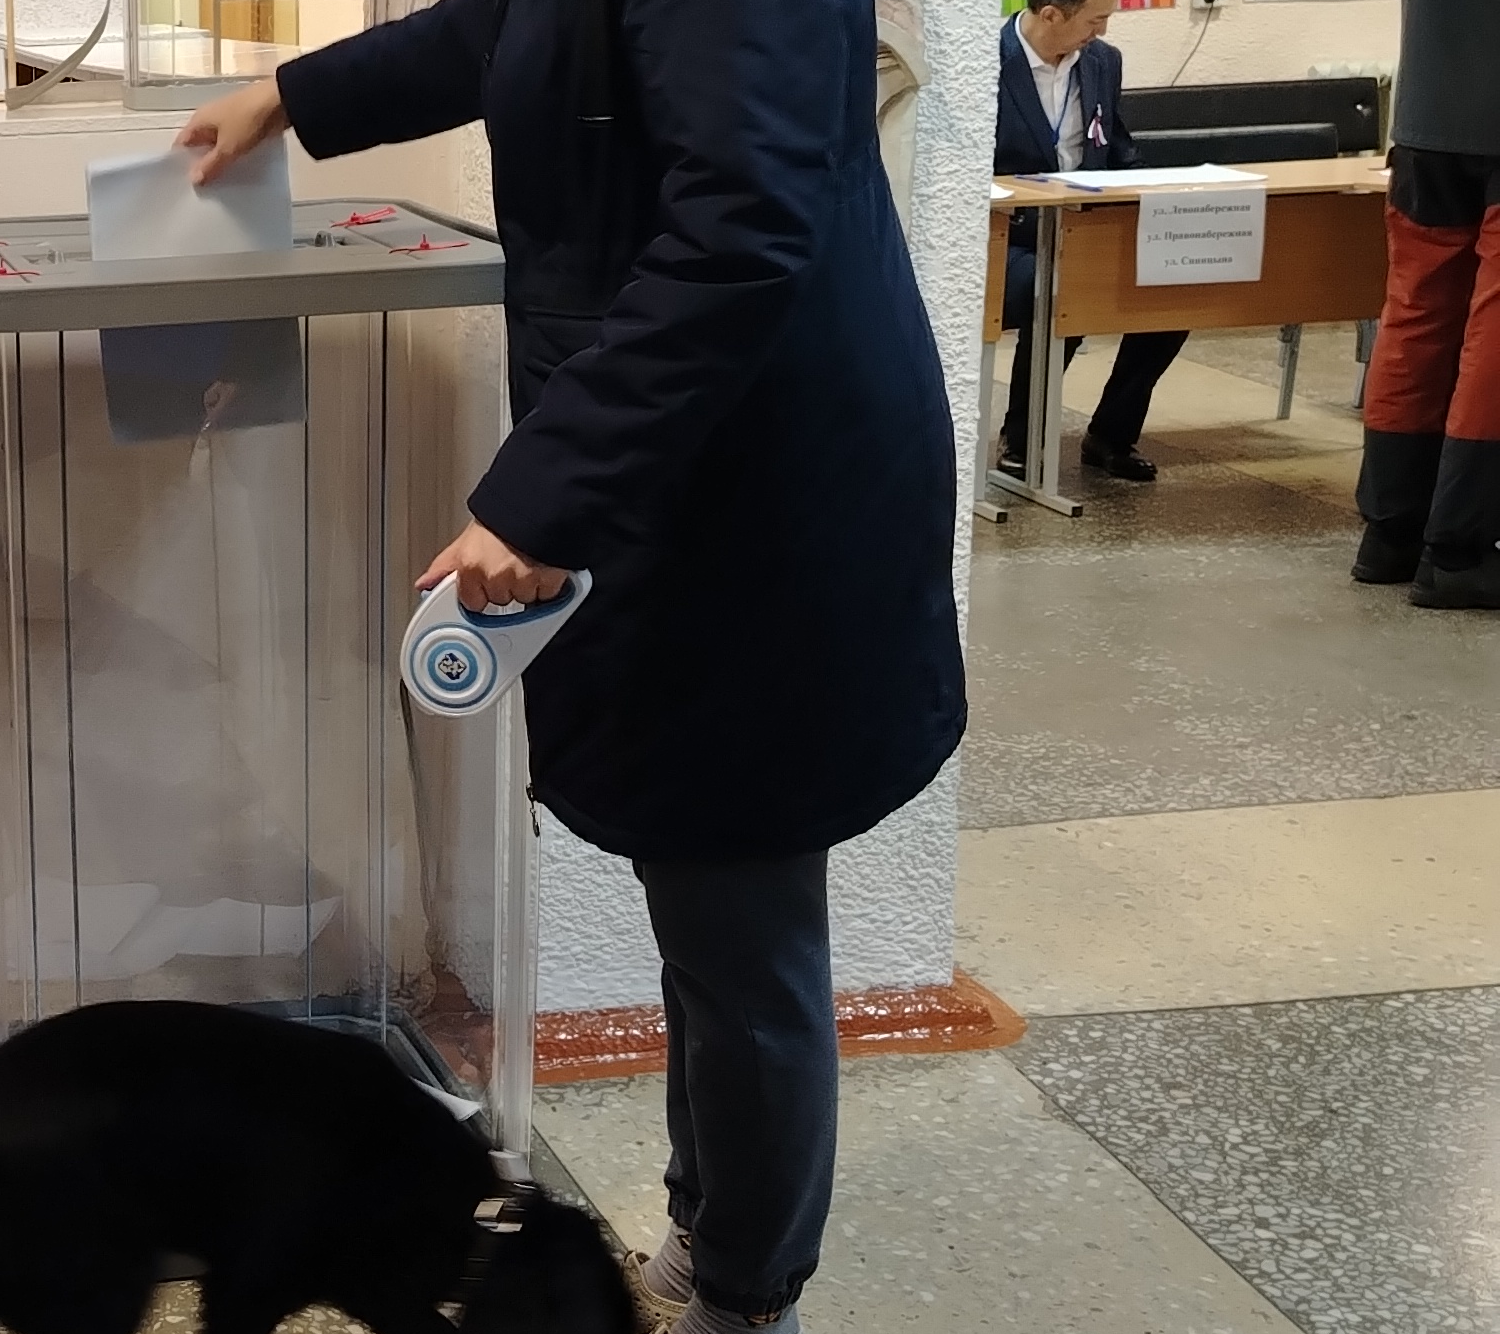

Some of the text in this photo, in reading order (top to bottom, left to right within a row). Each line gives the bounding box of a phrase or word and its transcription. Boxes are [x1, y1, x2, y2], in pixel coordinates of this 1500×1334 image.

[1168, 204, 1251, 215] Левонабережная
[1164, 229, 1253, 242] Правонабережная
[1181, 255, 1233, 266] Синицына
